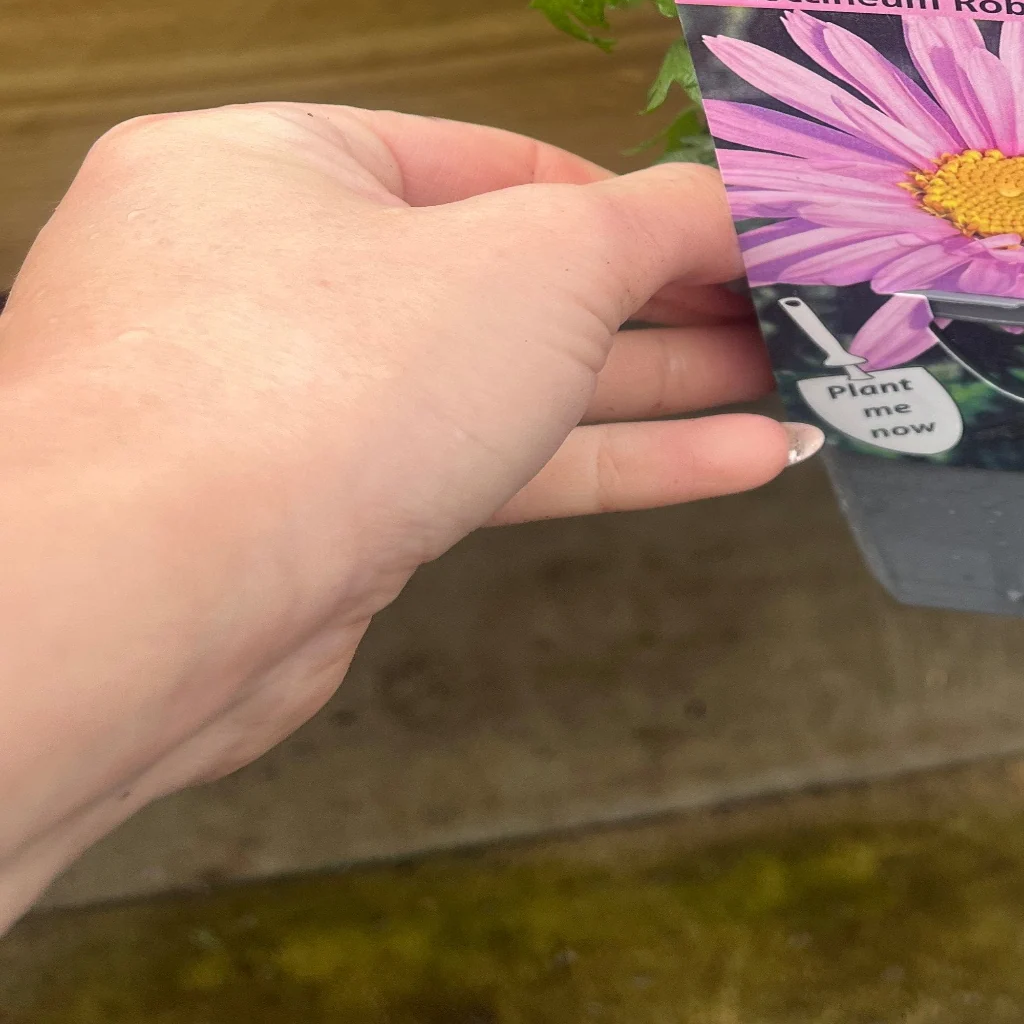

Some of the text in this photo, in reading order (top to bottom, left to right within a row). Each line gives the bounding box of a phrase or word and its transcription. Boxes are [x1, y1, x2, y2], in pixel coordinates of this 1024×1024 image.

[827, 379, 914, 399] Plant
[864, 403, 912, 418] me
[871, 422, 937, 439] now
